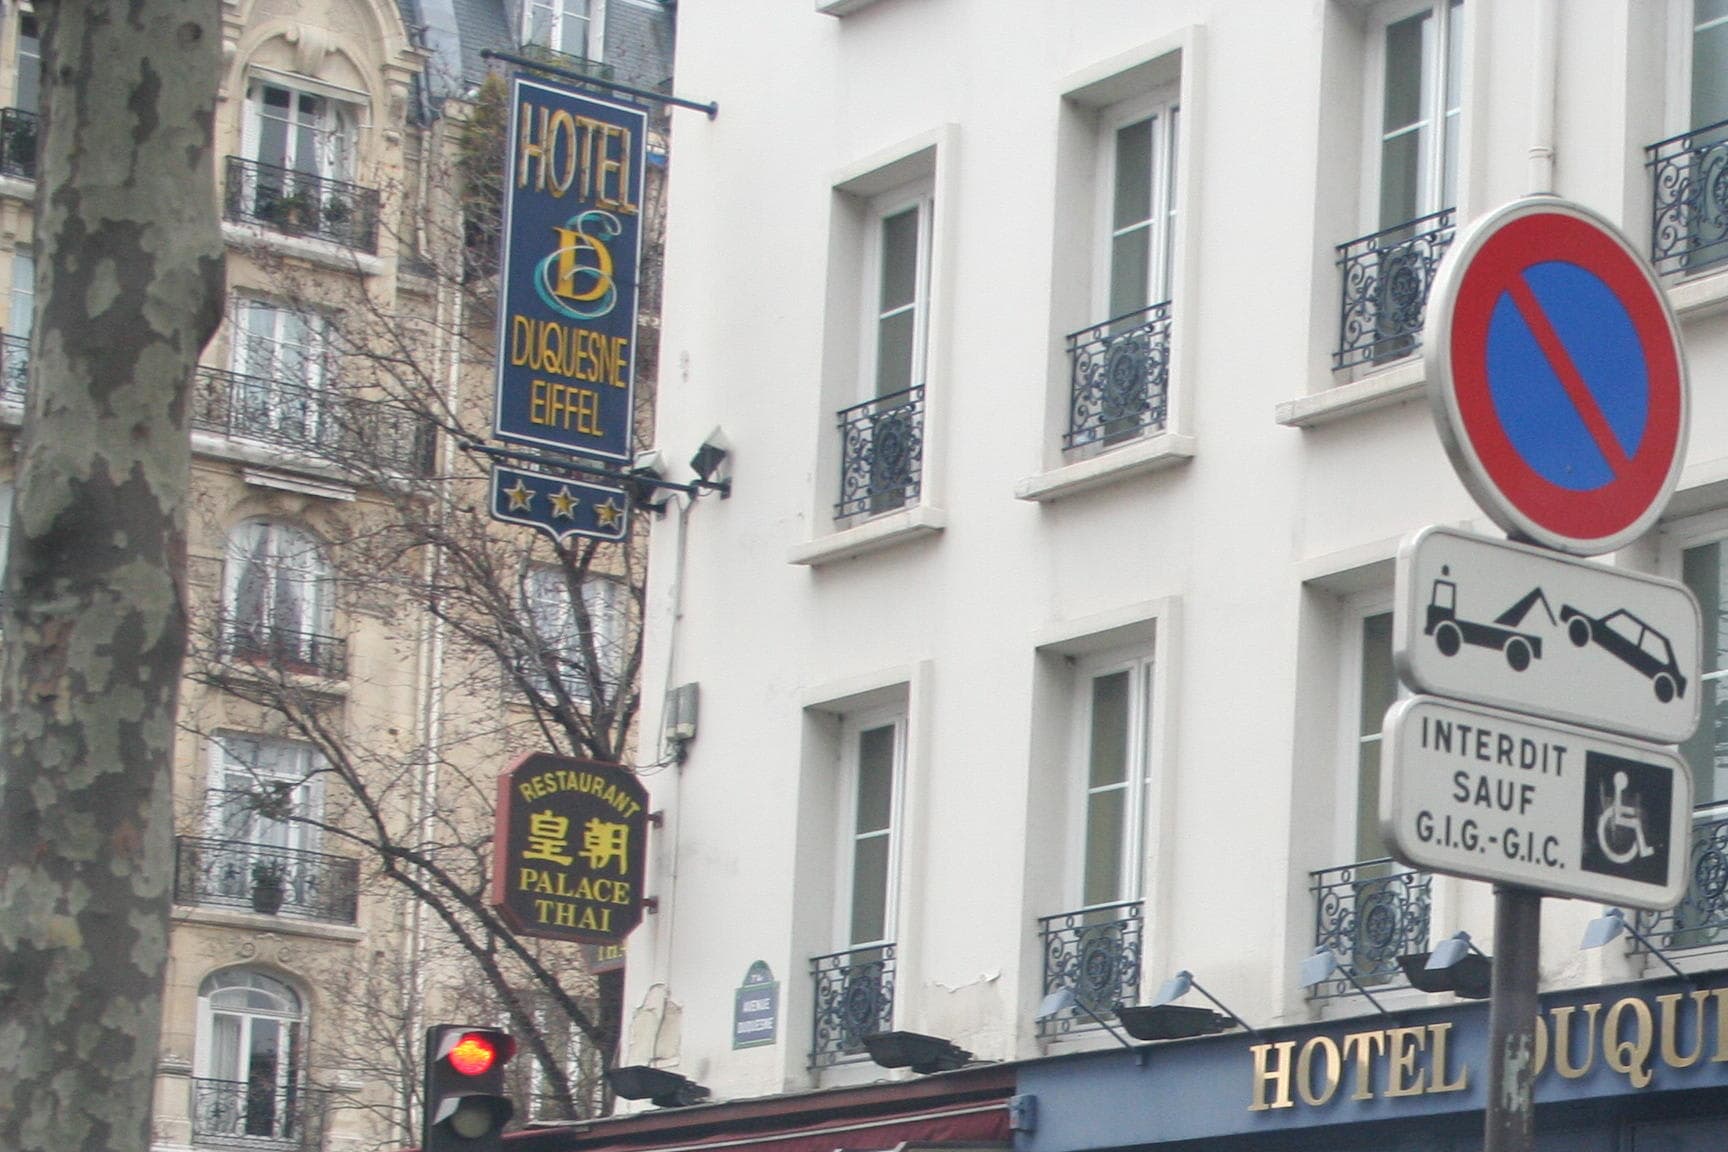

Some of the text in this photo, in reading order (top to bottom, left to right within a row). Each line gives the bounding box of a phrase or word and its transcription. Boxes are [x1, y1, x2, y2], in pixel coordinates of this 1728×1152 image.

[517, 102, 638, 214] HOTEL
[511, 314, 628, 389] DUQUESNE
[529, 379, 605, 437] EIFFEL
[1421, 716, 1568, 777] INTERDIT
[518, 770, 641, 819] RESTAURANT
[1452, 770, 1536, 816] SAUF
[1416, 810, 1566, 870] G.I.G.-G.I.C.
[519, 867, 631, 905] PALACE
[535, 899, 613, 933] THAI
[1247, 1021, 1468, 1112] HOTEL
